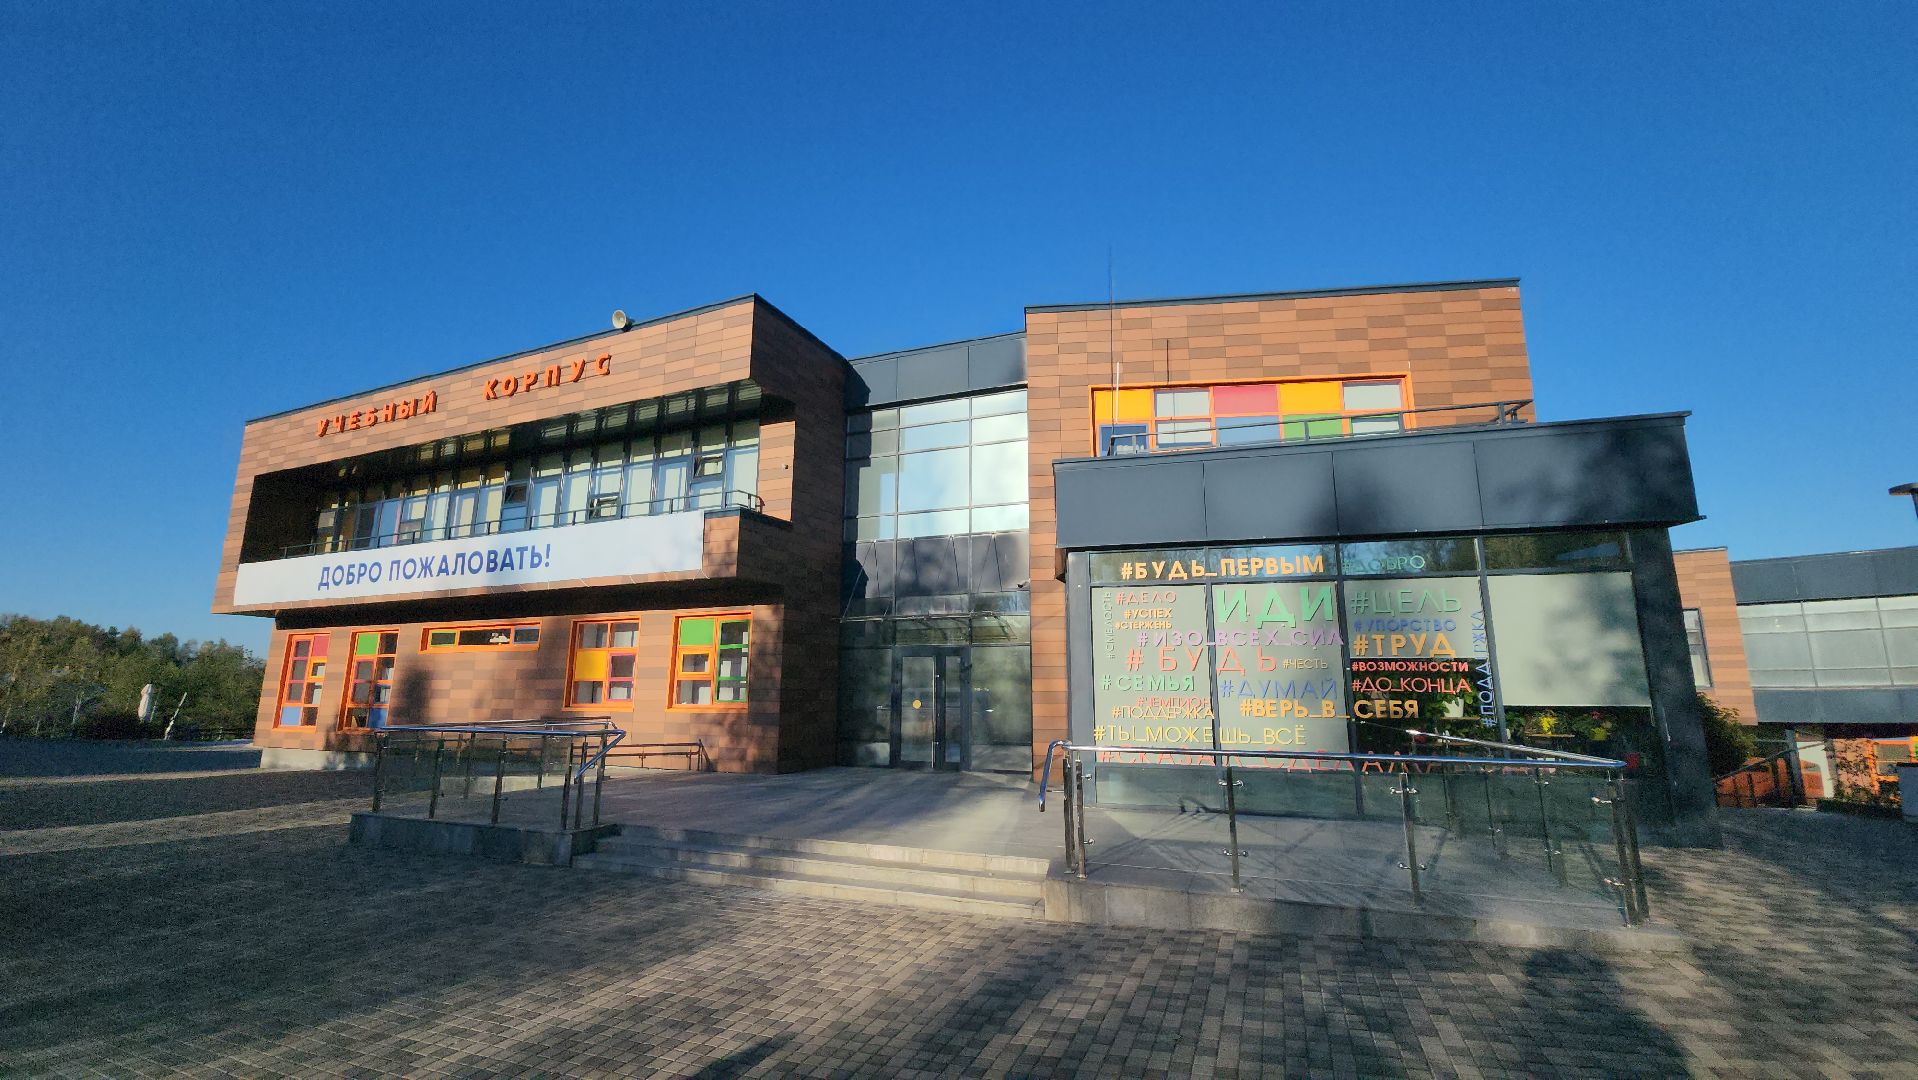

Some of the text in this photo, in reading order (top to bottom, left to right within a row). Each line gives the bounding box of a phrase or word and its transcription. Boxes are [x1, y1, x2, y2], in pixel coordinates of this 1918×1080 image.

[316, 352, 612, 437] УЧЕБНЫЙ КОРПУС
[317, 543, 551, 591] ДОБРО ПОЖАЛОВАТЬ!
[1121, 554, 1325, 581] #БУДЬ_ПЕРВЫМ
[1341, 555, 1426, 575] #ДОБРО
[1115, 591, 1177, 606] #ДЕЛО
[1216, 585, 1334, 629] ИДИ
[1351, 588, 1462, 618] #ЦЕЛЬ
[1124, 607, 1173, 620] #УСПЕХ
[1115, 620, 1173, 631] #СТЕРЖЕНЬ
[1353, 618, 1457, 632] #УПОРСТВО
[1353, 633, 1457, 660] #ТРУД
[1127, 645, 1277, 677] #БУДЬ
[1282, 658, 1329, 670] #ЧЕСТЬ
[1351, 661, 1469, 672] #ВОЗМОЖНОСТИ
[1101, 674, 1196, 692] #СЕМЬЯ
[1219, 676, 1339, 699] #ДУМАЙ
[1351, 676, 1473, 695] #ДО_КОНЦА
[1112, 704, 1215, 720] #ПОДДЕРЖКА
[1136, 696, 1210, 709] #ЧЕМПИОН
[1093, 724, 1307, 746] #ТЫ_МОЖЕШЬ_ВСЁ
